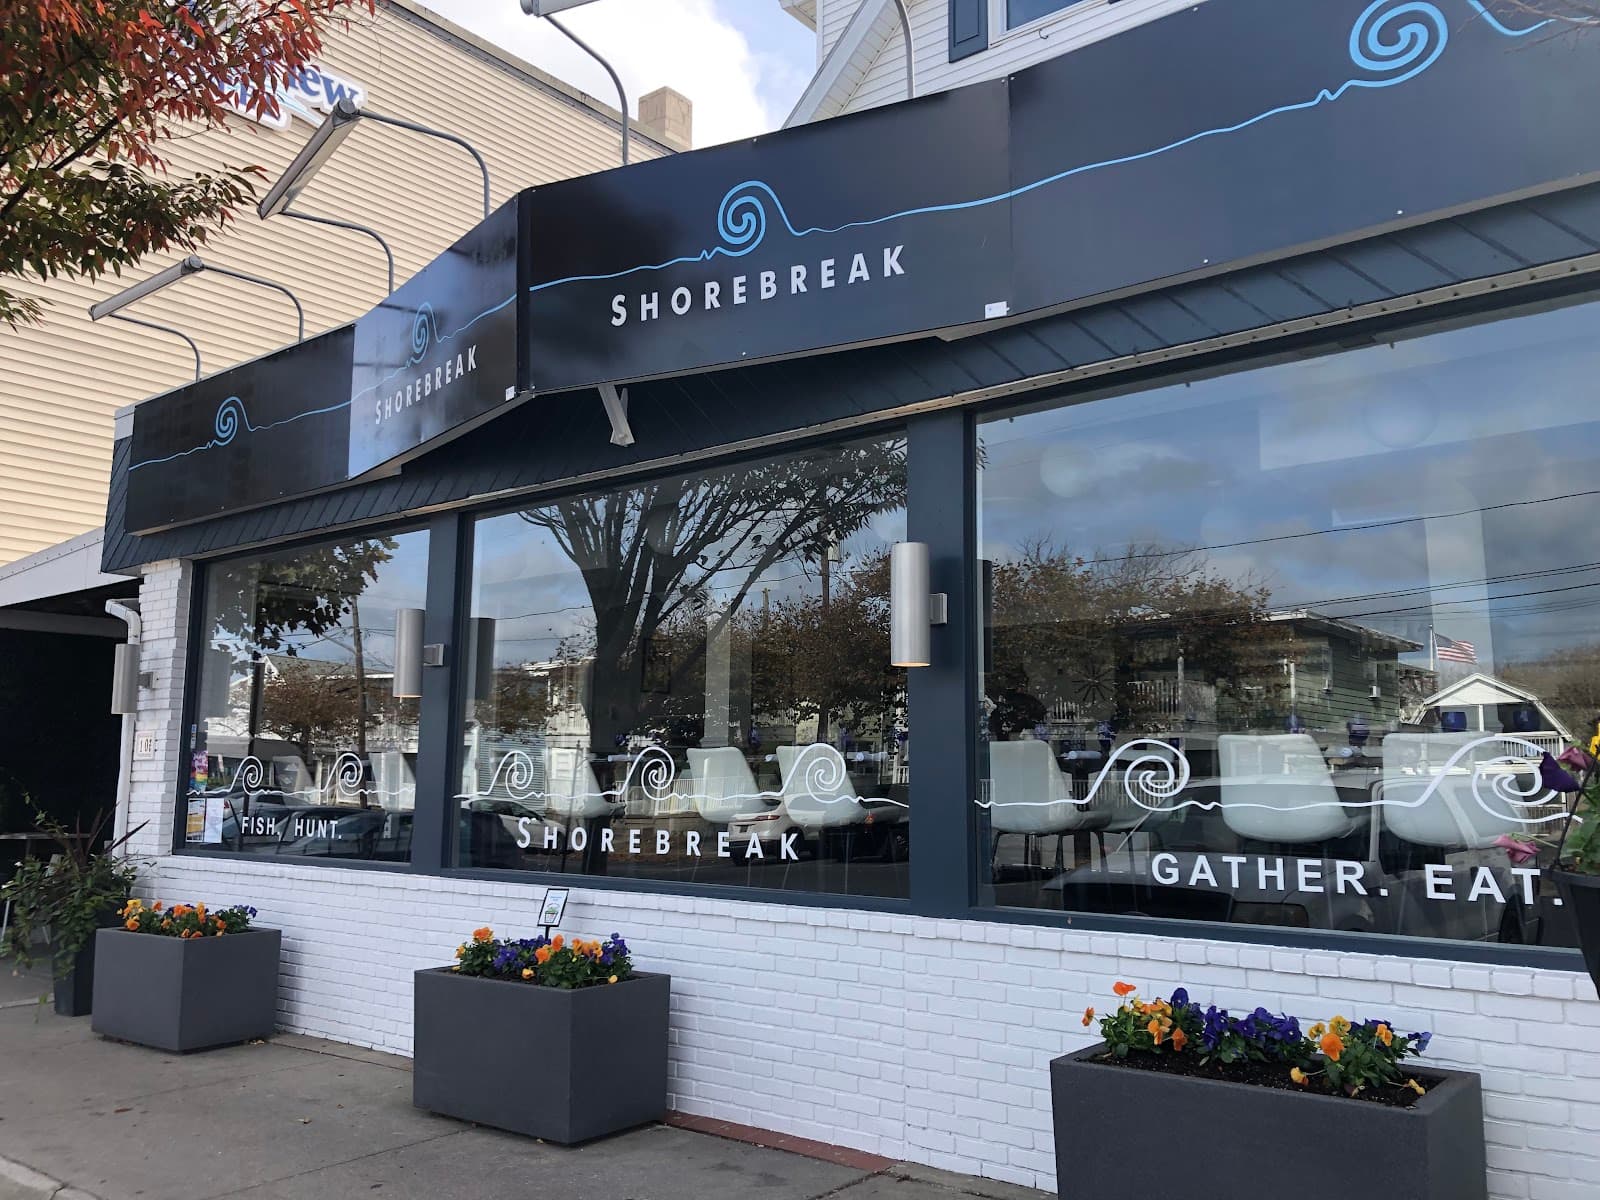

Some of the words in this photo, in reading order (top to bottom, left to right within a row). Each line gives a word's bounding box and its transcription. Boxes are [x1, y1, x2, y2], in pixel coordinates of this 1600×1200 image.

[611, 245, 905, 326] SHOREBREAK
[375, 345, 477, 425] SHOREBREAK
[294, 818, 342, 840] HUNT.
[516, 817, 799, 861] SHOREBREAK
[1151, 853, 1389, 897] GATHER.
[1425, 863, 1565, 906] EAT.
